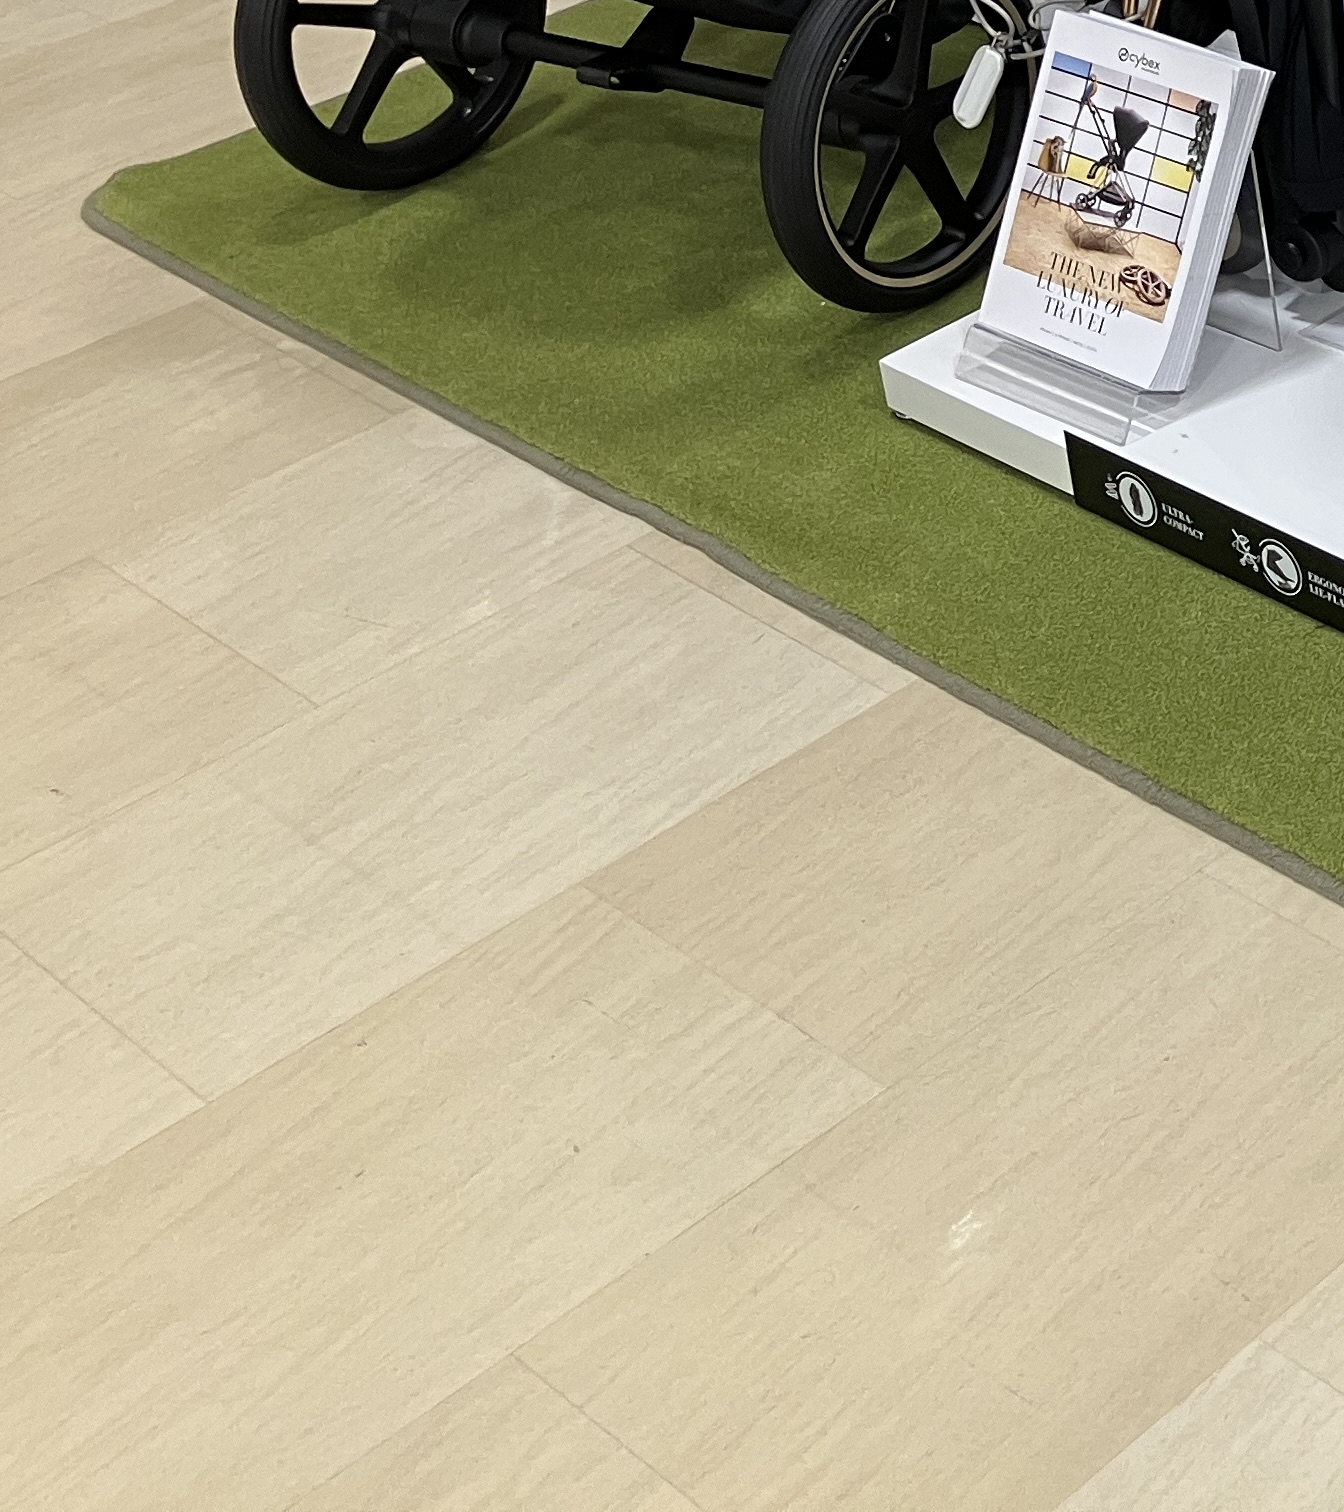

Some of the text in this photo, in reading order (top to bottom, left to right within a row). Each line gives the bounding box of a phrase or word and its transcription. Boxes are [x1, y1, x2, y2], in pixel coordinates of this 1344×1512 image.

[1129, 52, 1161, 70] cybex
[1050, 251, 1084, 278] THE
[1035, 269, 1130, 319] LUXURY OF
[1043, 294, 1108, 337] TRAVEL
[1162, 514, 1205, 542] COMPACT
